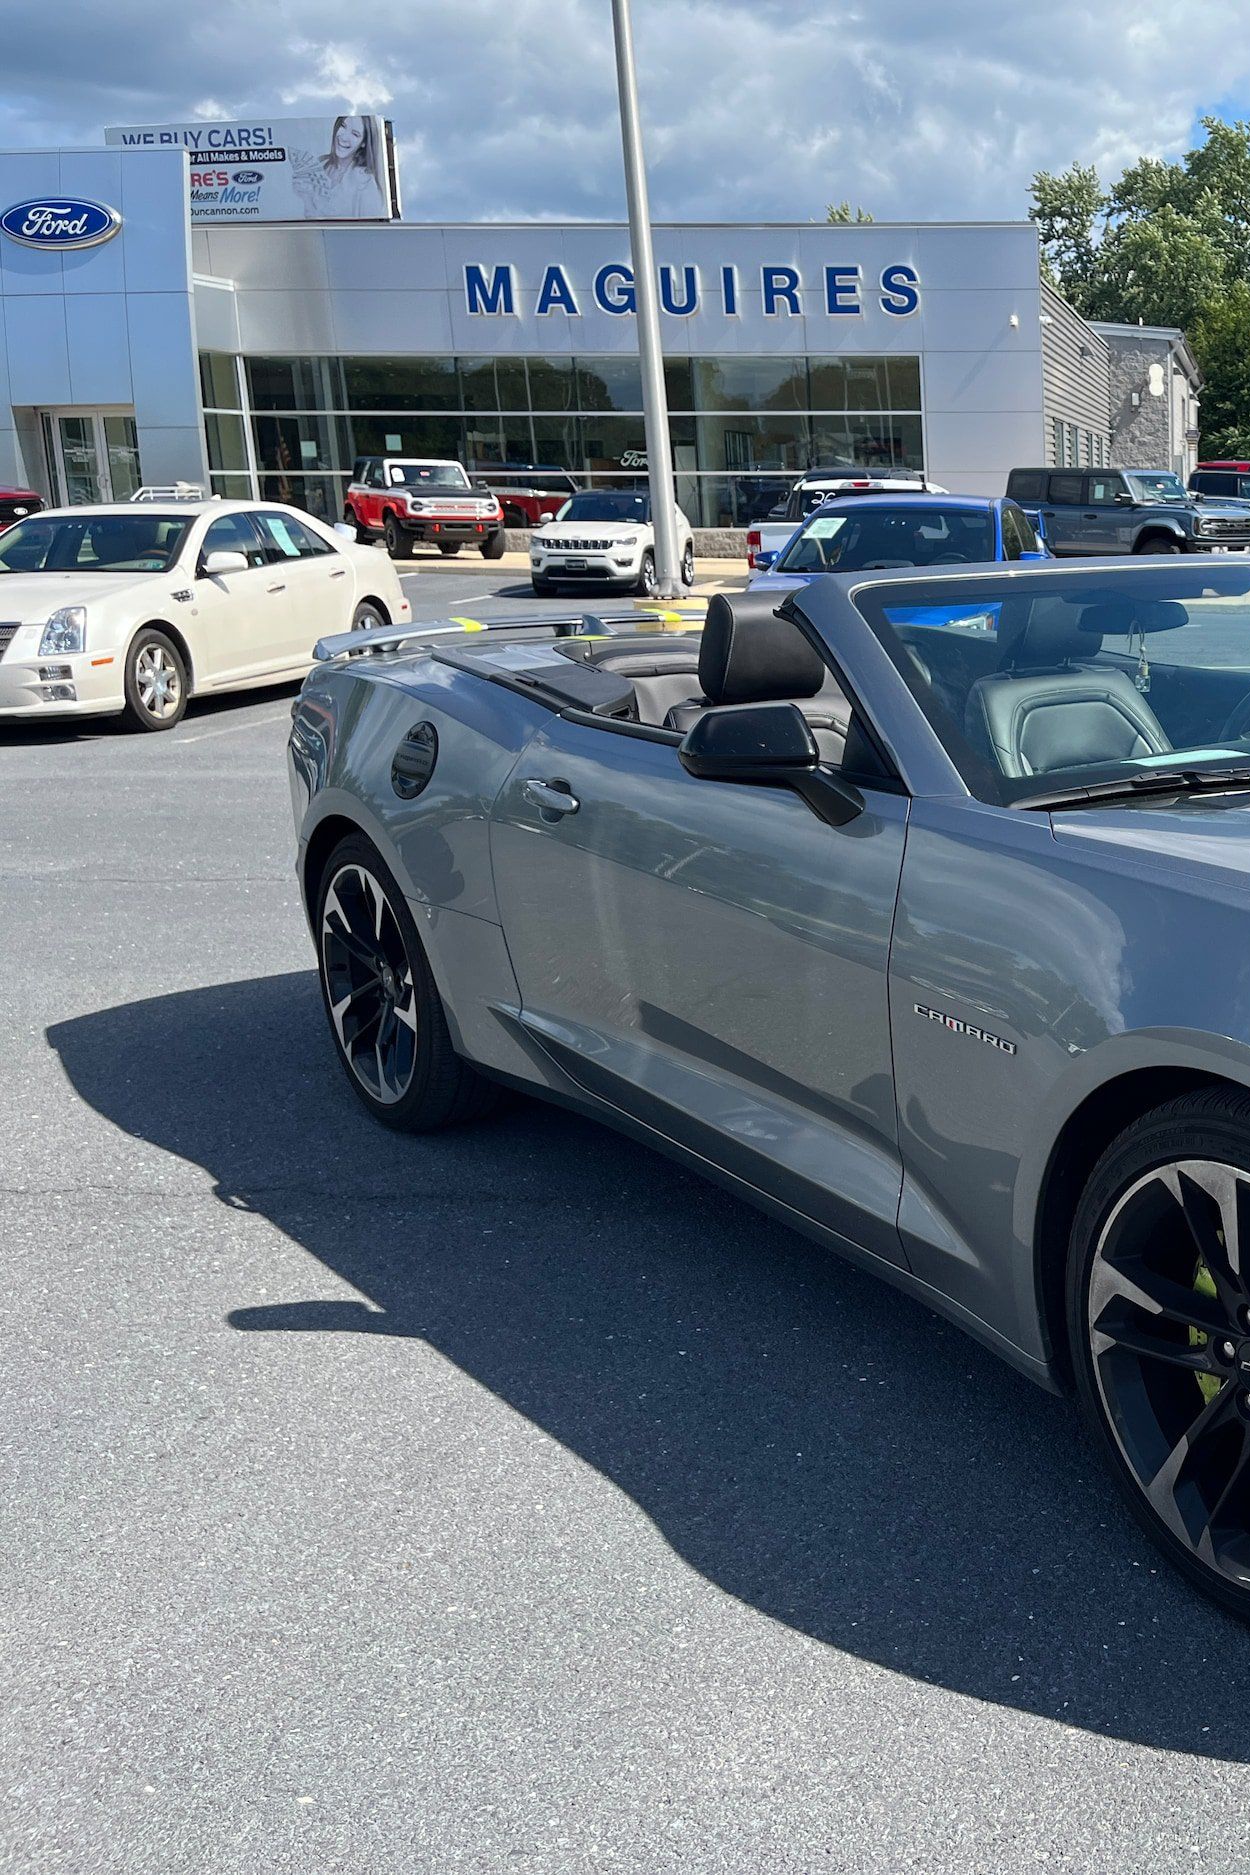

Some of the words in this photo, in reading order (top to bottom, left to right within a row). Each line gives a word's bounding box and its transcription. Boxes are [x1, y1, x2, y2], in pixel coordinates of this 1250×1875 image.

[207, 127, 274, 148] CARS!
[197, 152, 209, 163] All
[210, 151, 240, 162] Makes
[241, 152, 248, 161] &
[249, 150, 283, 161] Models
[220, 186, 261, 204] More!
[22, 207, 88, 235] Ford
[464, 265, 919, 315] MAGUIRES
[620, 450, 648, 467] For
[914, 1003, 1017, 1055] CAMARO
